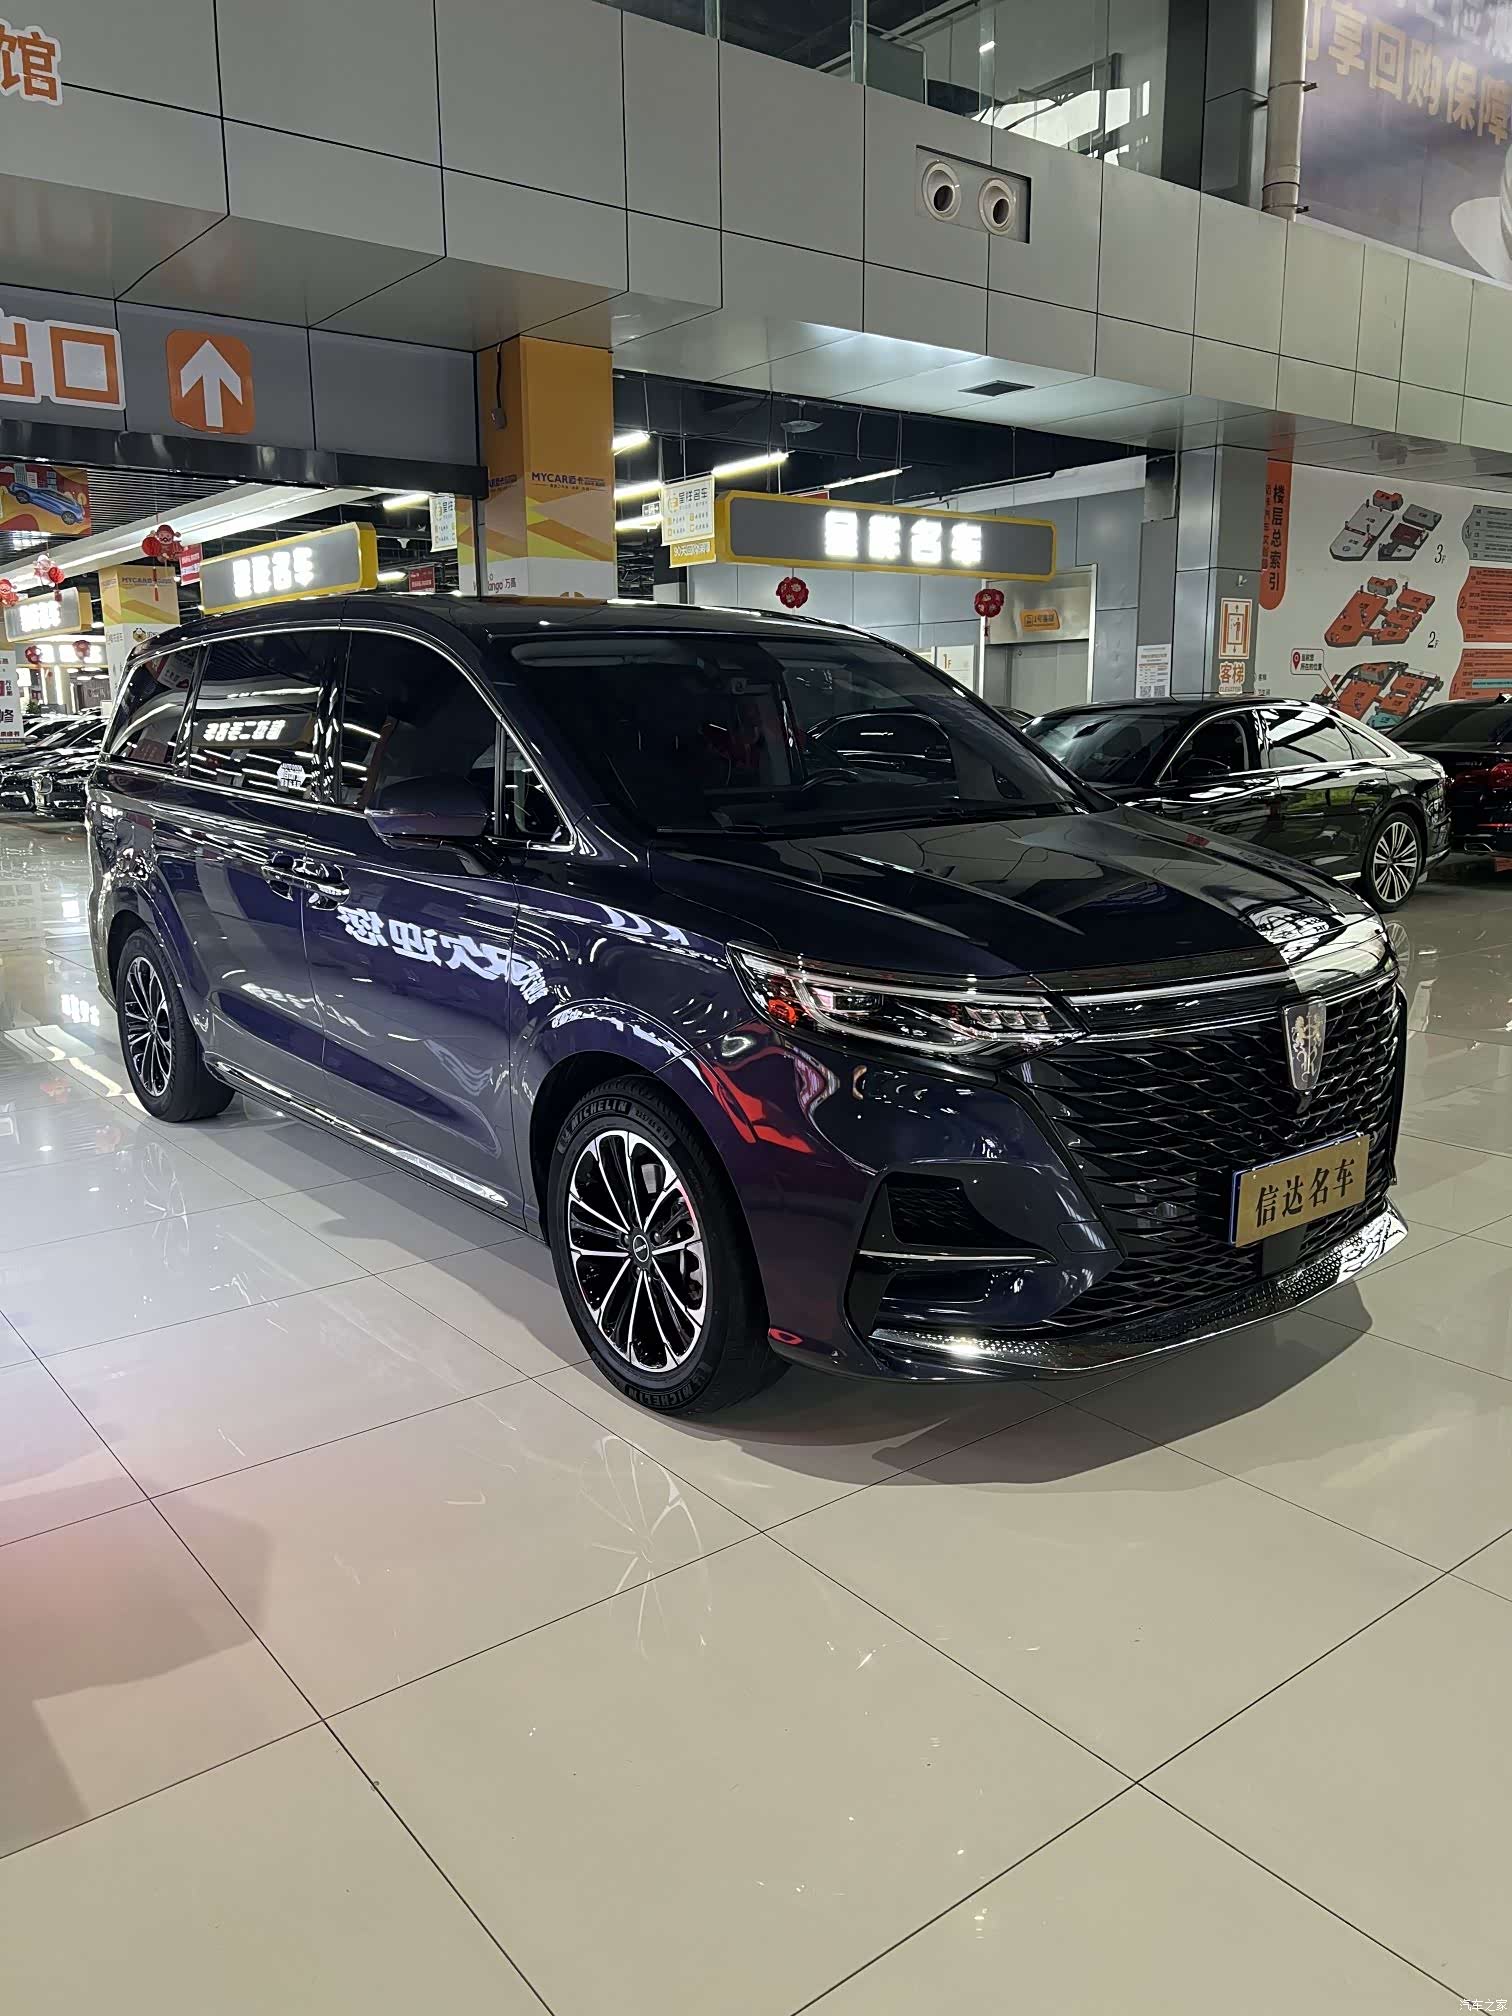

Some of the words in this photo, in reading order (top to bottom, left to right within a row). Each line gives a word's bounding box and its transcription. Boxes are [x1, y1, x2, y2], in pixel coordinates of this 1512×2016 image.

[0, 23, 57, 101] 馆
[1268, 484, 1285, 591] 楼层总索引
[1220, 664, 1244, 683] 客梯
[571, 1099, 628, 1130] MICHELIN
[1255, 1158, 1354, 1229] 信达名车
